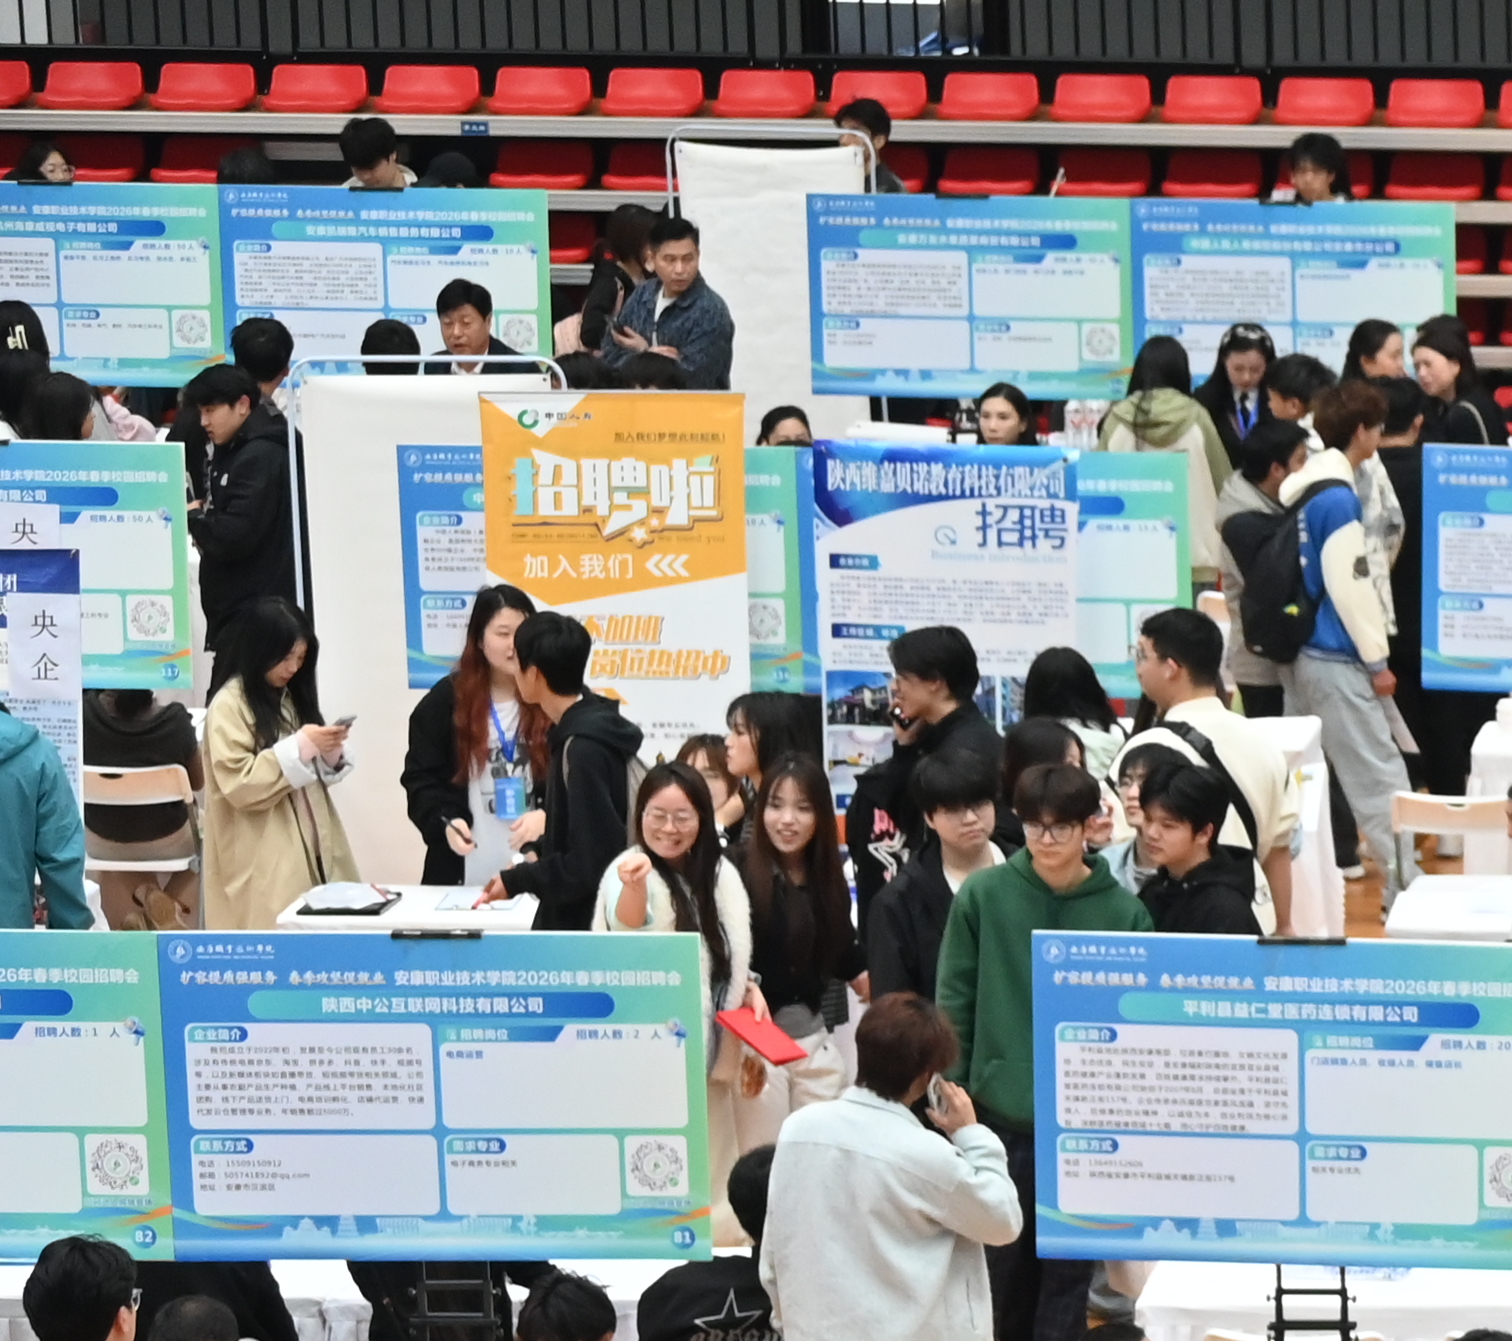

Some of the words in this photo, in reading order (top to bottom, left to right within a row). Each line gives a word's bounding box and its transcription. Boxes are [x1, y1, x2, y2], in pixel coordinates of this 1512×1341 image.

[826, 458, 1066, 499] 陕西维嘉贝诺教育科技有限公司
[511, 448, 723, 538] 招聘啦
[975, 502, 1069, 551] 招聘
[523, 553, 634, 580] 加入我们
[30, 605, 60, 683] 央企
[394, 969, 682, 987] 安康职业技术学院2026年春季校园招聘会
[321, 996, 544, 1015] 陕西中公互联网科技有限公司
[1182, 1000, 1419, 1024] 平利县益仁堂医药连锁有限公司
[135, 1229, 153, 1244] 82
[674, 1231, 693, 1245] 81
